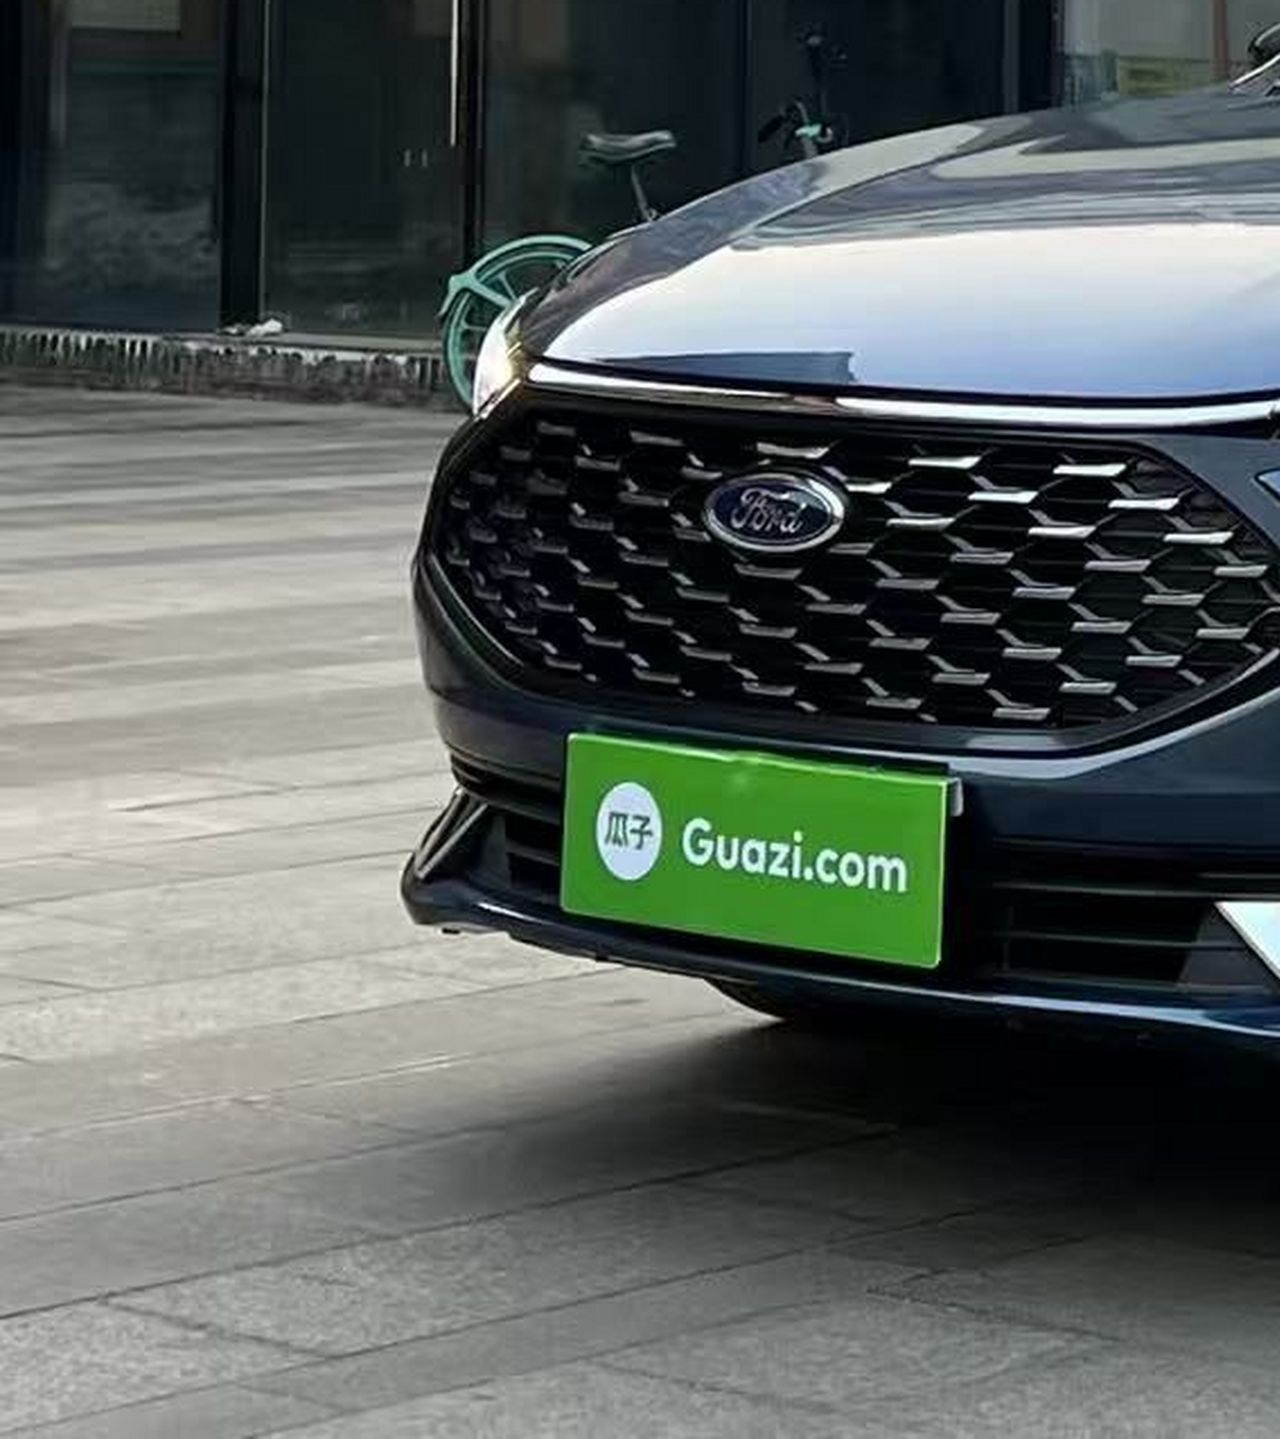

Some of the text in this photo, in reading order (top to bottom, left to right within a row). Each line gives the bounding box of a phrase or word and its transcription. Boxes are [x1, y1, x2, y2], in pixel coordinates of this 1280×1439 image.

[731, 488, 807, 533] Ford
[604, 811, 653, 851] 瓜子
[683, 818, 907, 893] Guazi.com
